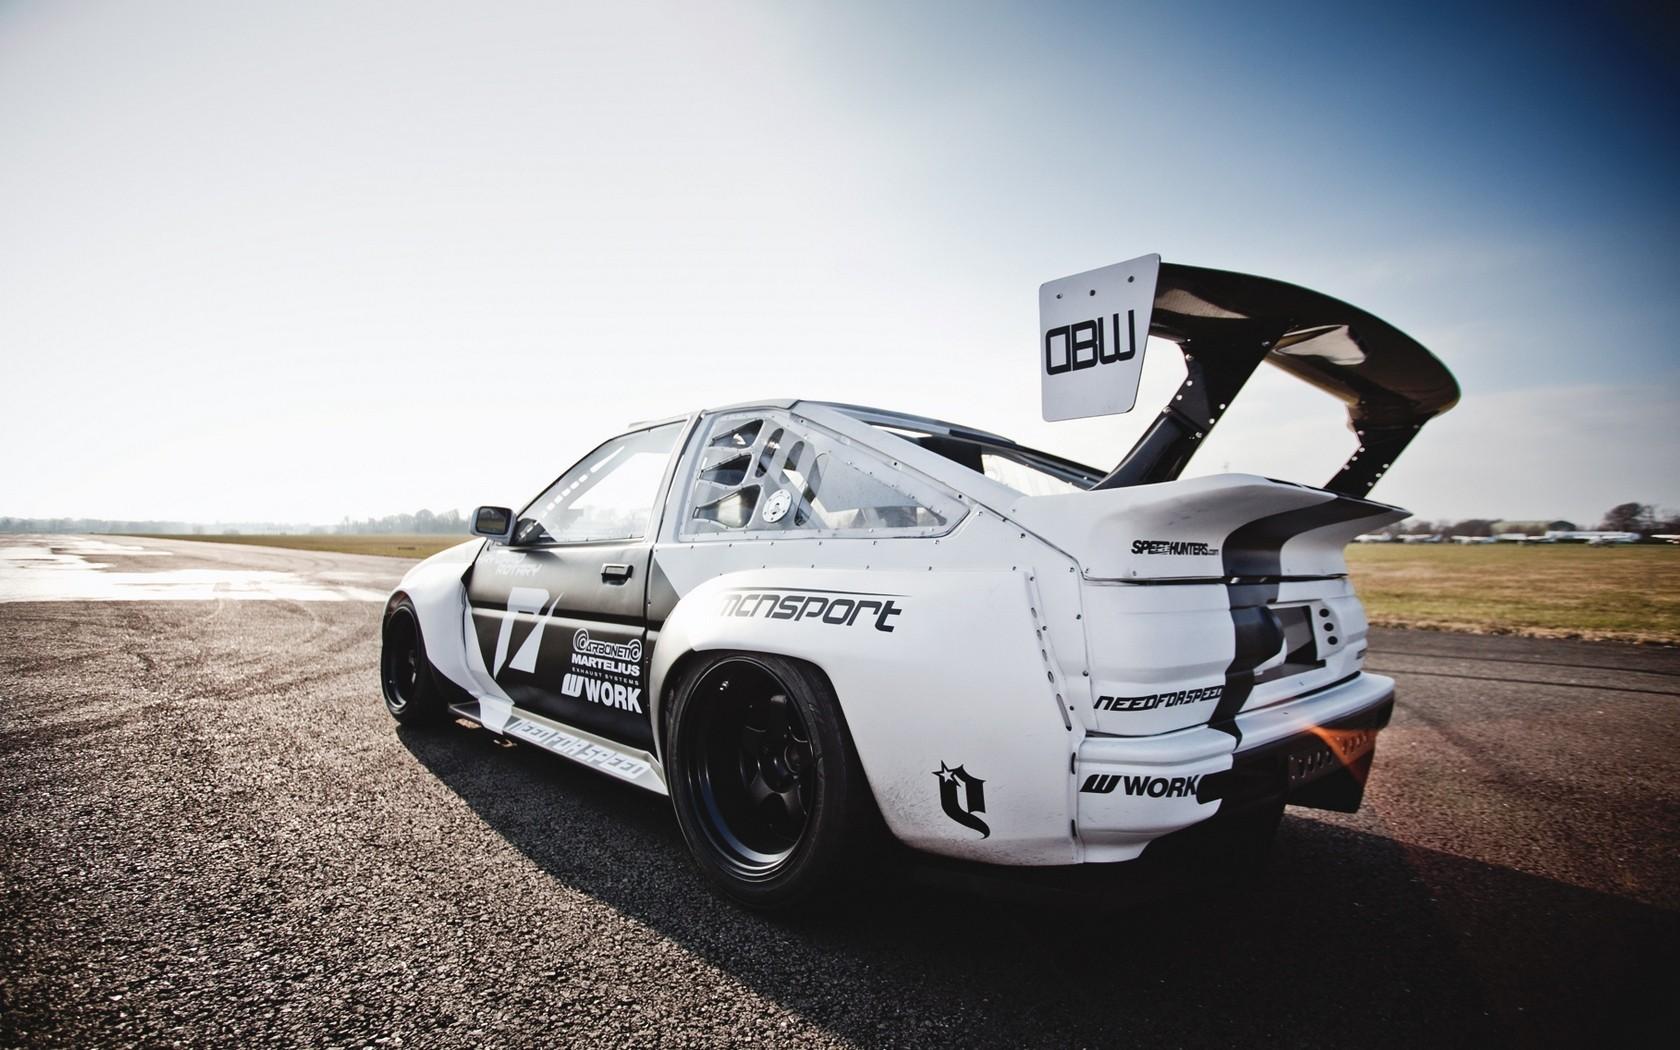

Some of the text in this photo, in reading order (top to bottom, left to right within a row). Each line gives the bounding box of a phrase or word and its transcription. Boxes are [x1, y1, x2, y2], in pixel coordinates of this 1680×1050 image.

[571, 653, 640, 677] MARTELIUS
[571, 666, 639, 686] EXHAUST SYSTEMS
[584, 677, 643, 714] WORK
[1123, 774, 1200, 798] WORK
